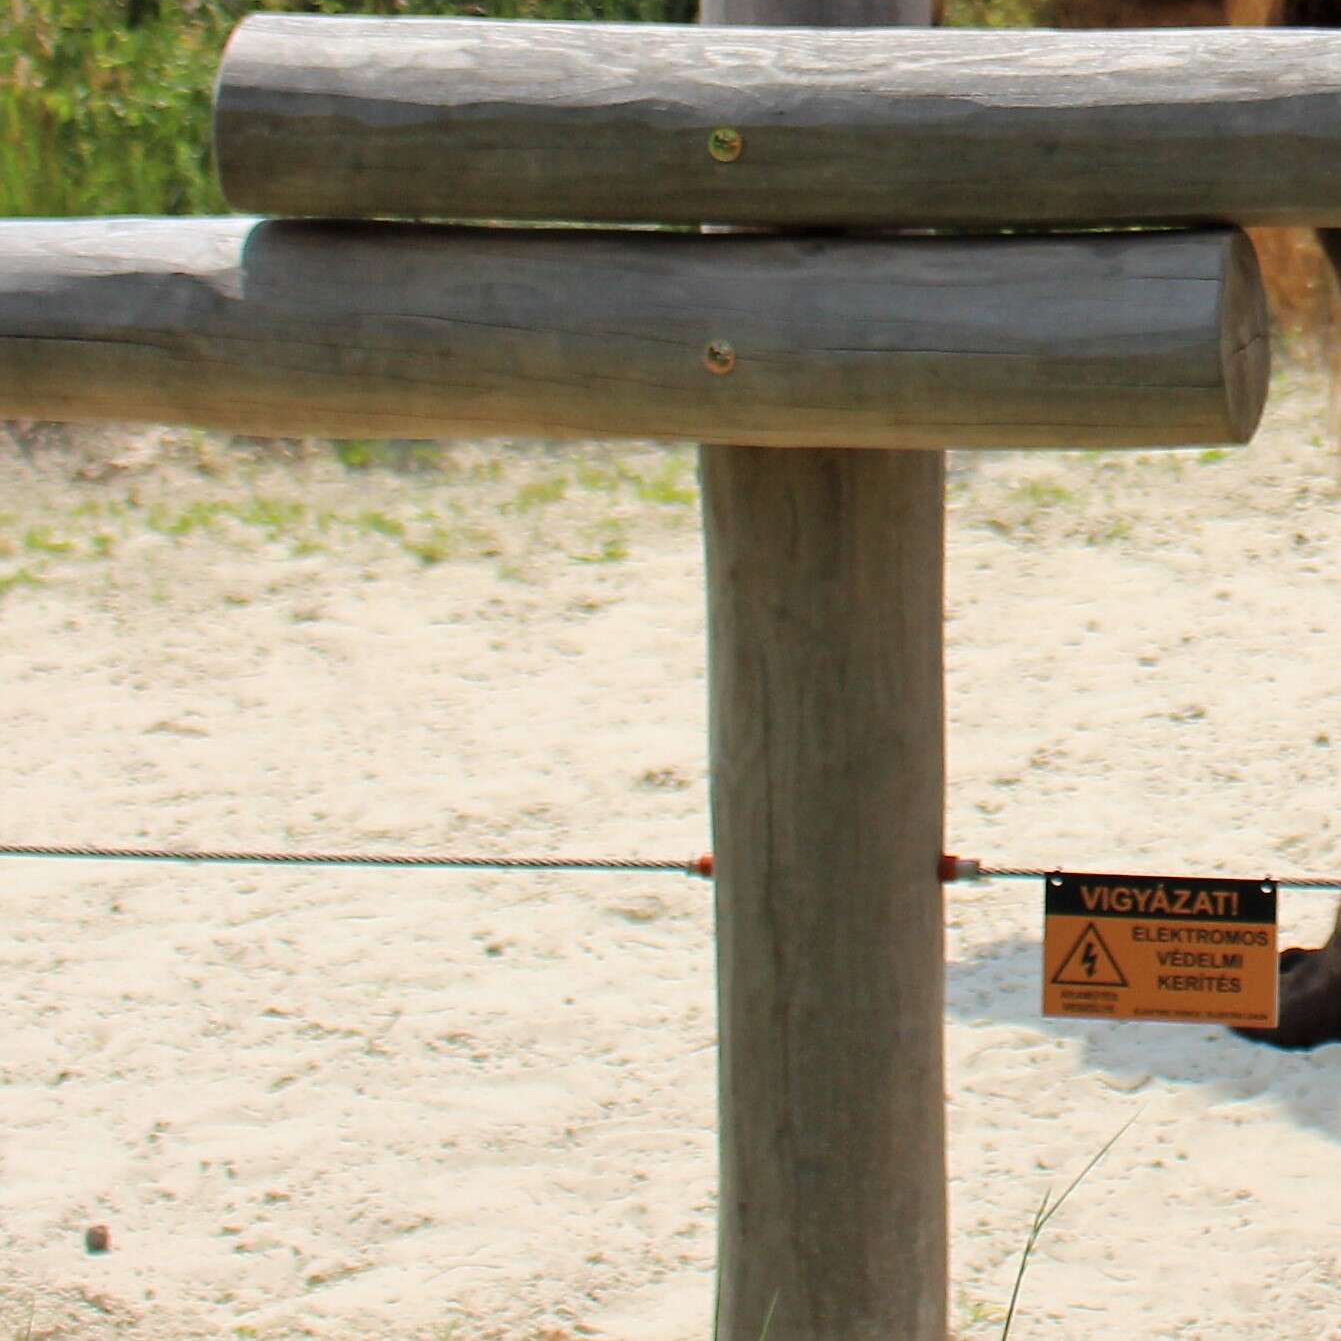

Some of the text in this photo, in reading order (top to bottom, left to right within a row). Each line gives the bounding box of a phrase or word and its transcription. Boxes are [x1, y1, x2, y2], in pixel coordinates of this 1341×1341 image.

[1079, 884, 1239, 916] VIGYÁZAT!
[1132, 926, 1269, 947] ELEKTROMOS
[1157, 949, 1244, 969] VÉDELMI
[1158, 974, 1242, 994] KERÍTÉS
